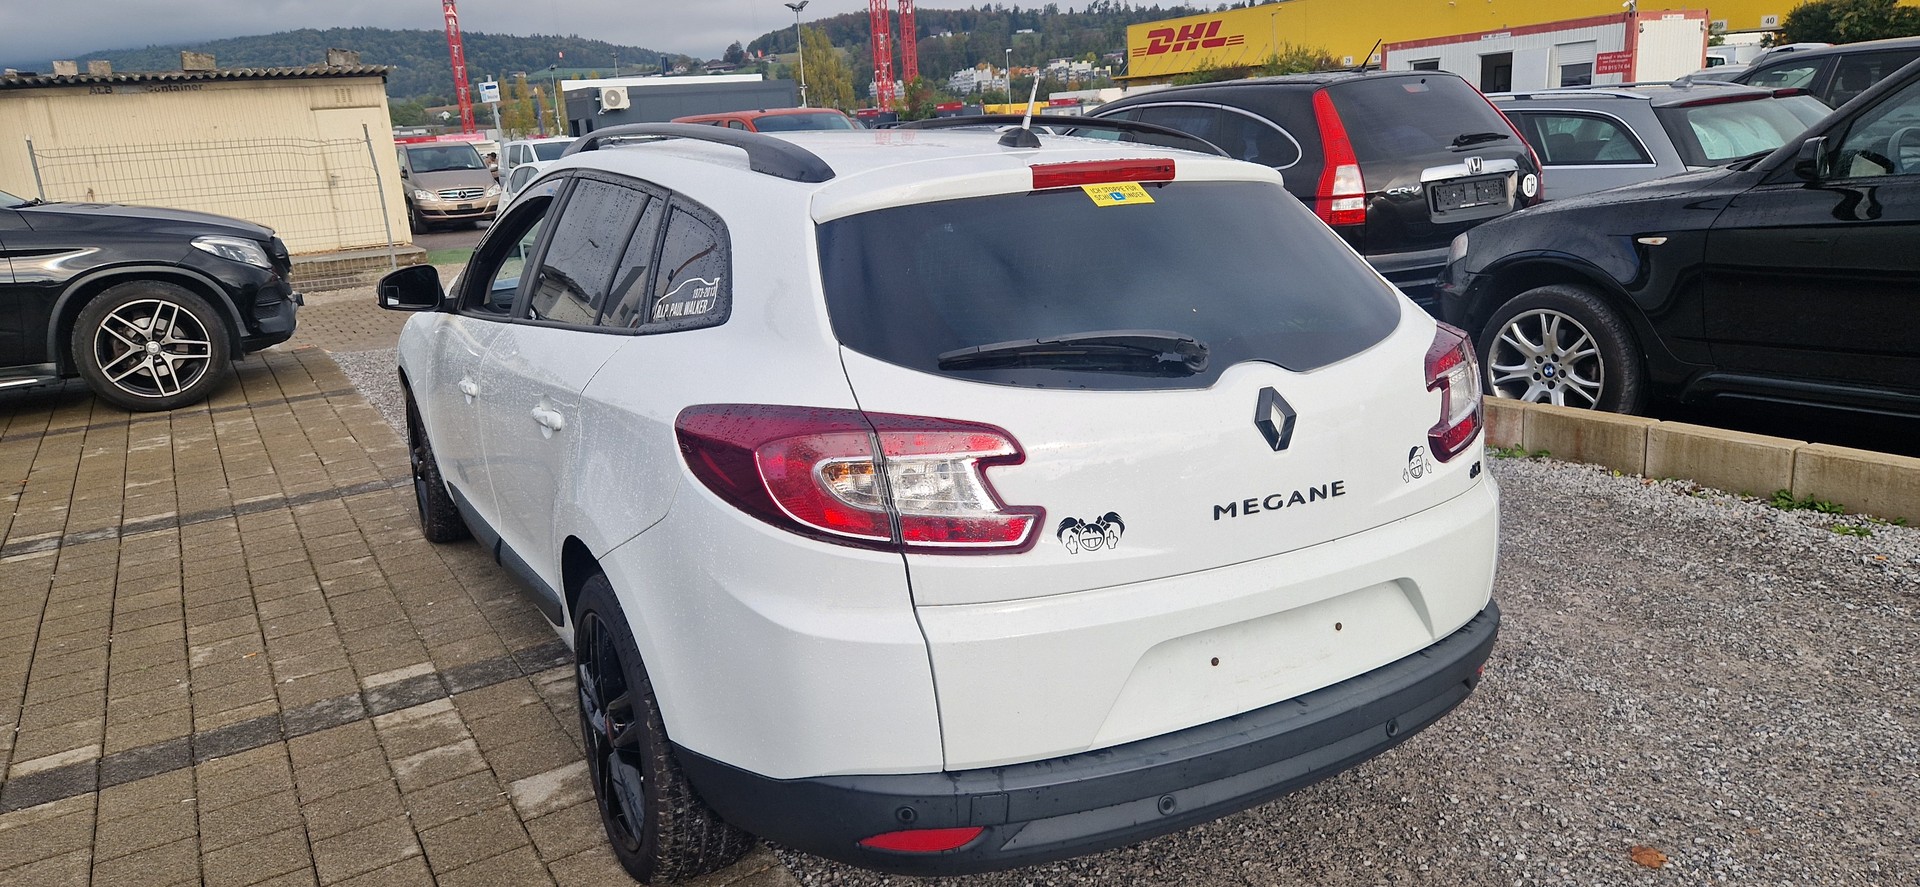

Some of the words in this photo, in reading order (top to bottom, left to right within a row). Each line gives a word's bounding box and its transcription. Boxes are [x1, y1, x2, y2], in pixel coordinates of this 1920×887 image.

[1765, 17, 1775, 25] 40
[1146, 20, 1228, 56] DHL
[1386, 185, 1421, 196] CR-V
[1526, 176, 1535, 194] CH
[692, 287, 716, 299] 1973-2013
[669, 301, 684, 317] PAUL
[684, 299, 708, 316] WALKER
[1213, 480, 1346, 521] MEGANE
